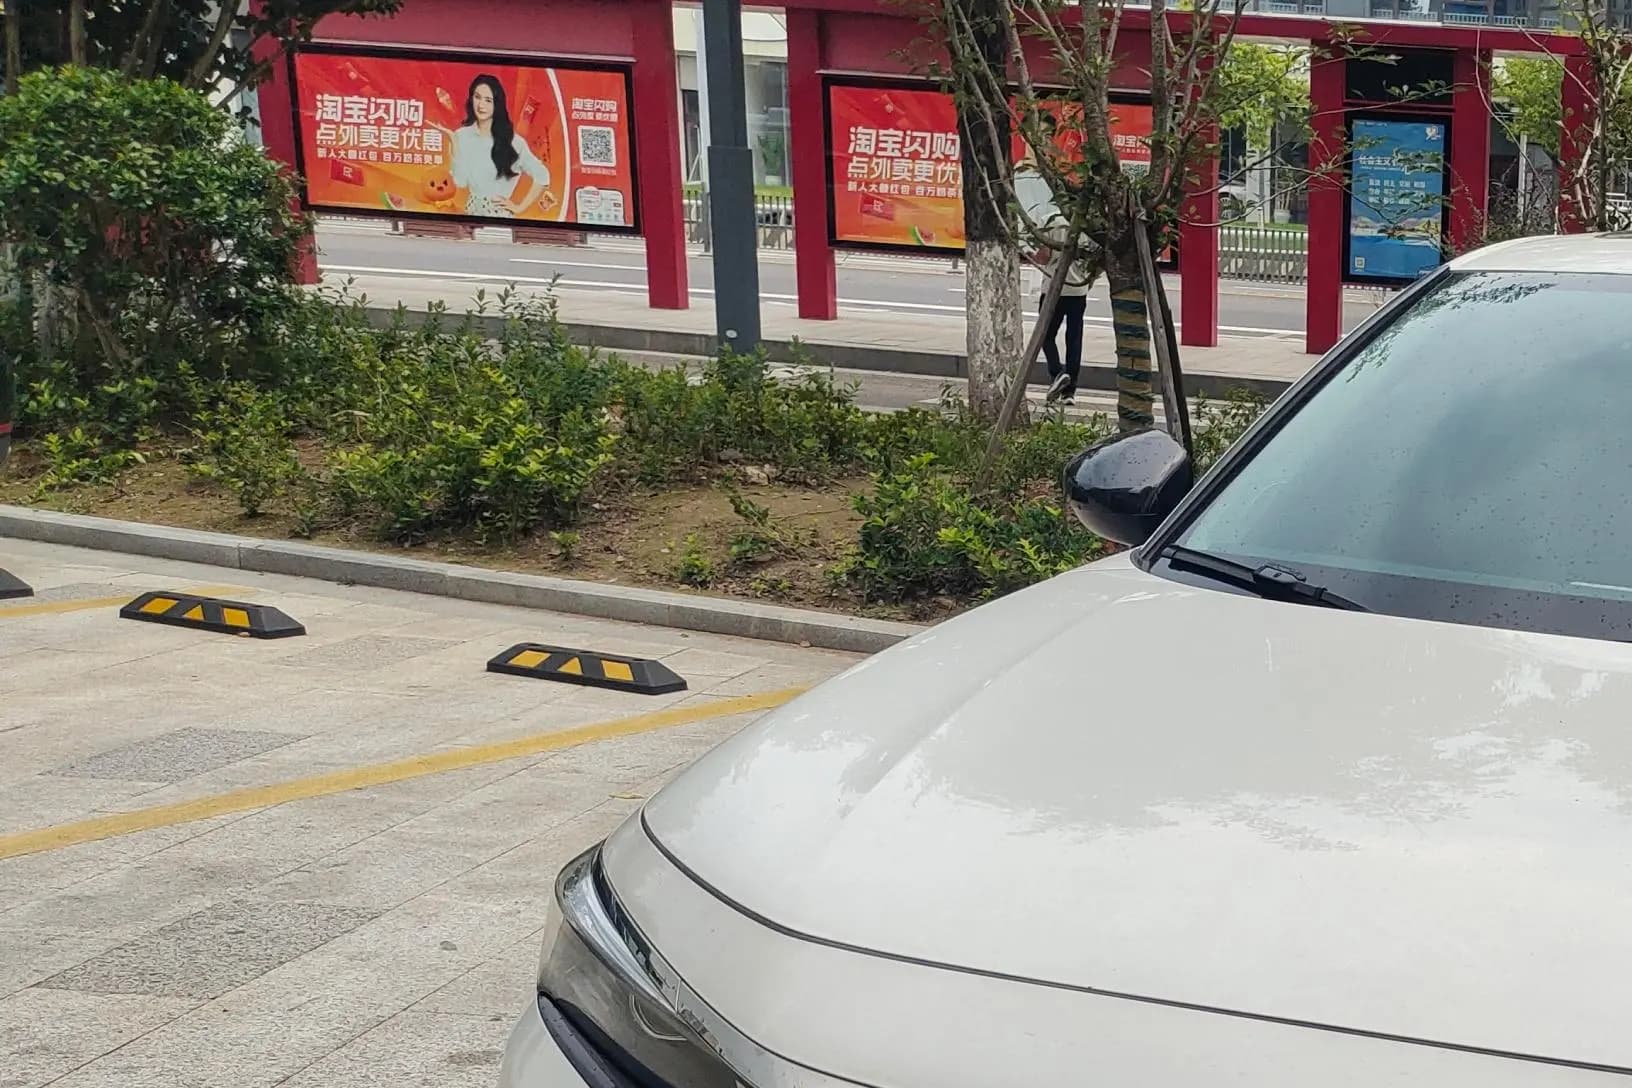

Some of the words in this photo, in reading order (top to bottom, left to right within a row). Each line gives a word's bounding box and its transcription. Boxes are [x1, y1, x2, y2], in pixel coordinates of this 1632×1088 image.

[316, 94, 424, 126] 淘宝闪购
[316, 122, 443, 151] 点外卖更优惠
[847, 126, 960, 160] 淘宝闪购
[847, 156, 962, 184] 点外卖更优
[915, 185, 962, 198] 百万奶茶
